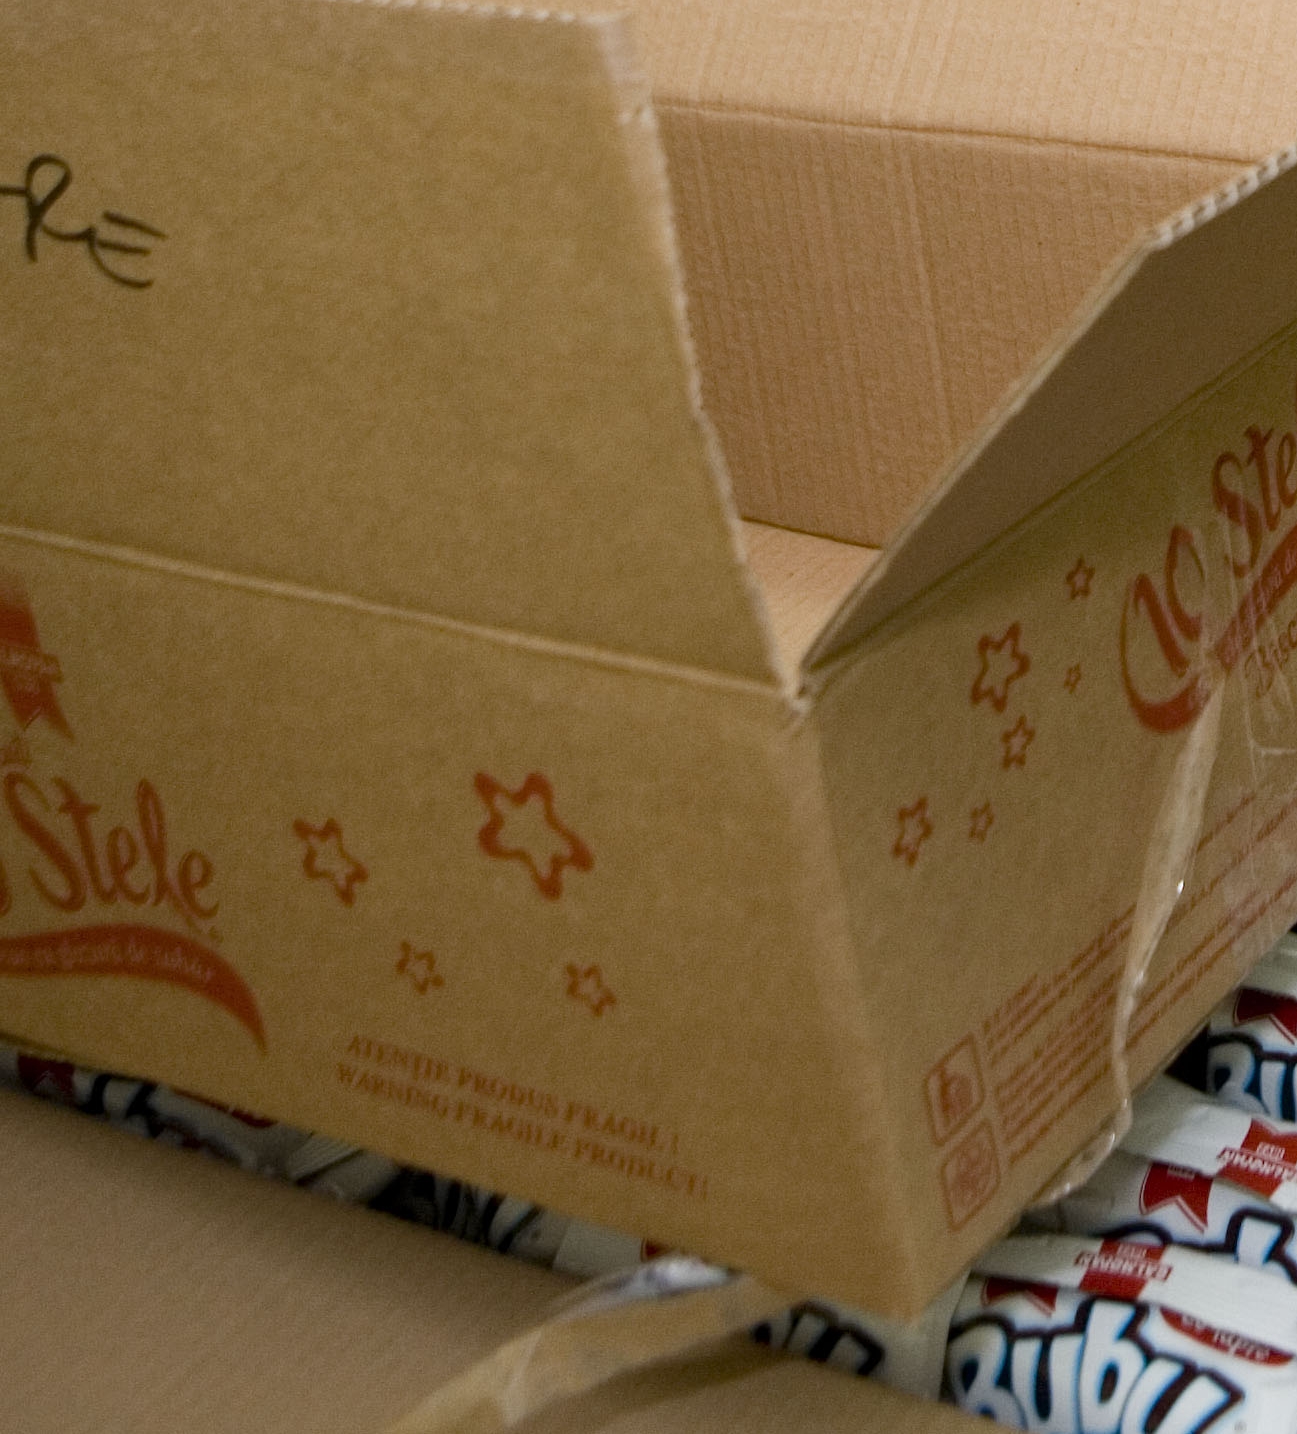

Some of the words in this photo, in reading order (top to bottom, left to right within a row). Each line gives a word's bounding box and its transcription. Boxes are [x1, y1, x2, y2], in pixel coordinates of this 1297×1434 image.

[0, 153, 169, 289] RE
[4, 771, 220, 918] Stele
[943, 1294, 1246, 1434] Bubu
